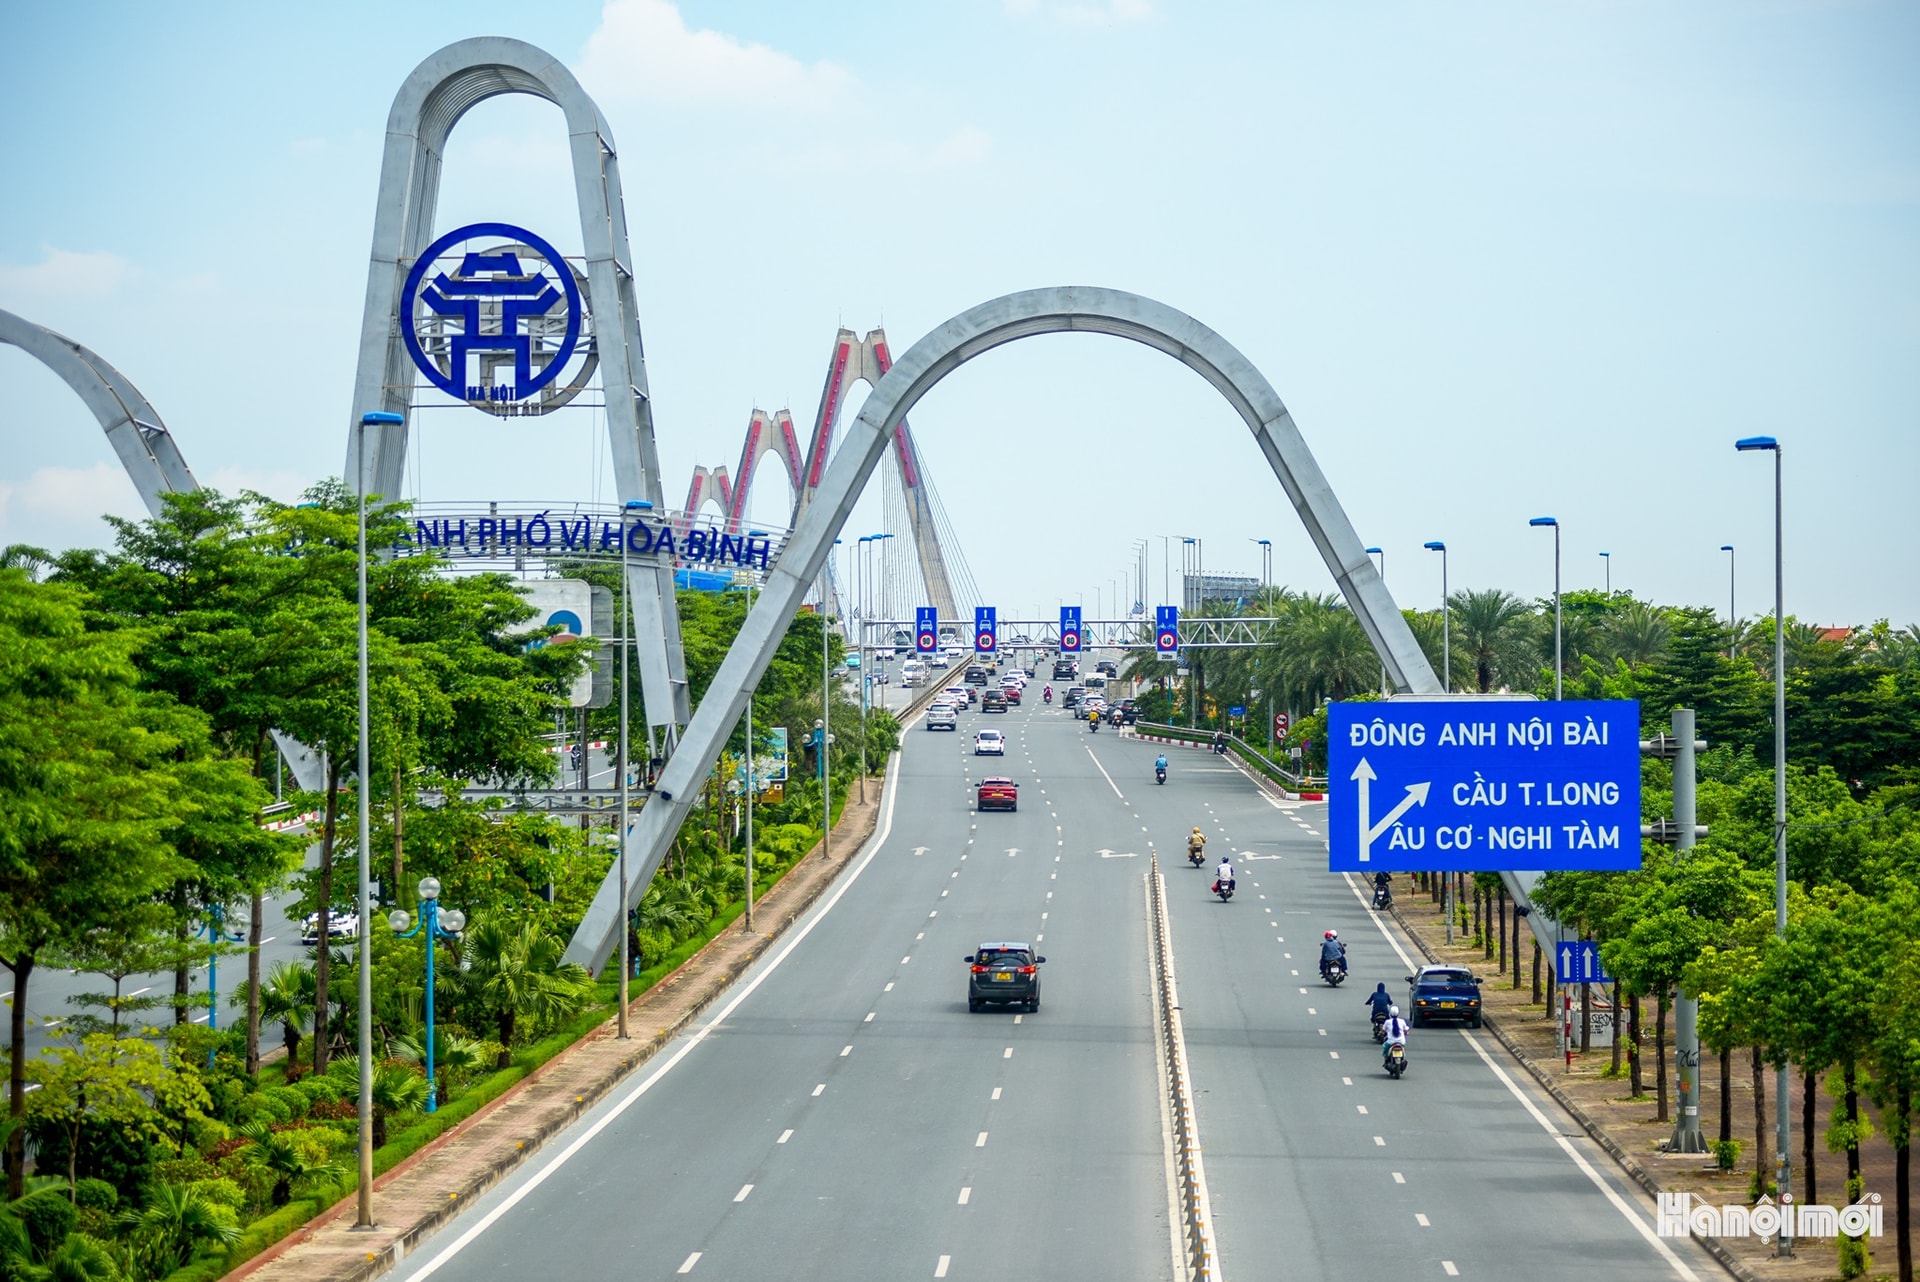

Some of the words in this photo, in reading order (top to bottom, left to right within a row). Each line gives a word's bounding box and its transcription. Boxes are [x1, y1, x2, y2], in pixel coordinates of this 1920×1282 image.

[479, 510, 551, 546] PHỐ
[559, 514, 591, 552] VÌ
[602, 519, 676, 555] HÒA
[687, 526, 770, 570] BÌNH
[981, 637, 990, 645] 80
[1066, 636, 1075, 644] 80
[1162, 637, 1171, 645] 40
[1350, 717, 1426, 747] ĐÔNG
[1438, 722, 1496, 746] ANH
[1508, 716, 1552, 751] NỘI
[1564, 716, 1608, 746] BÀI
[1453, 771, 1508, 806] CẦU
[1518, 782, 1620, 806] T.LONG
[1388, 822, 1425, 850] ÂU
[1563, 820, 1620, 850] TÀM
